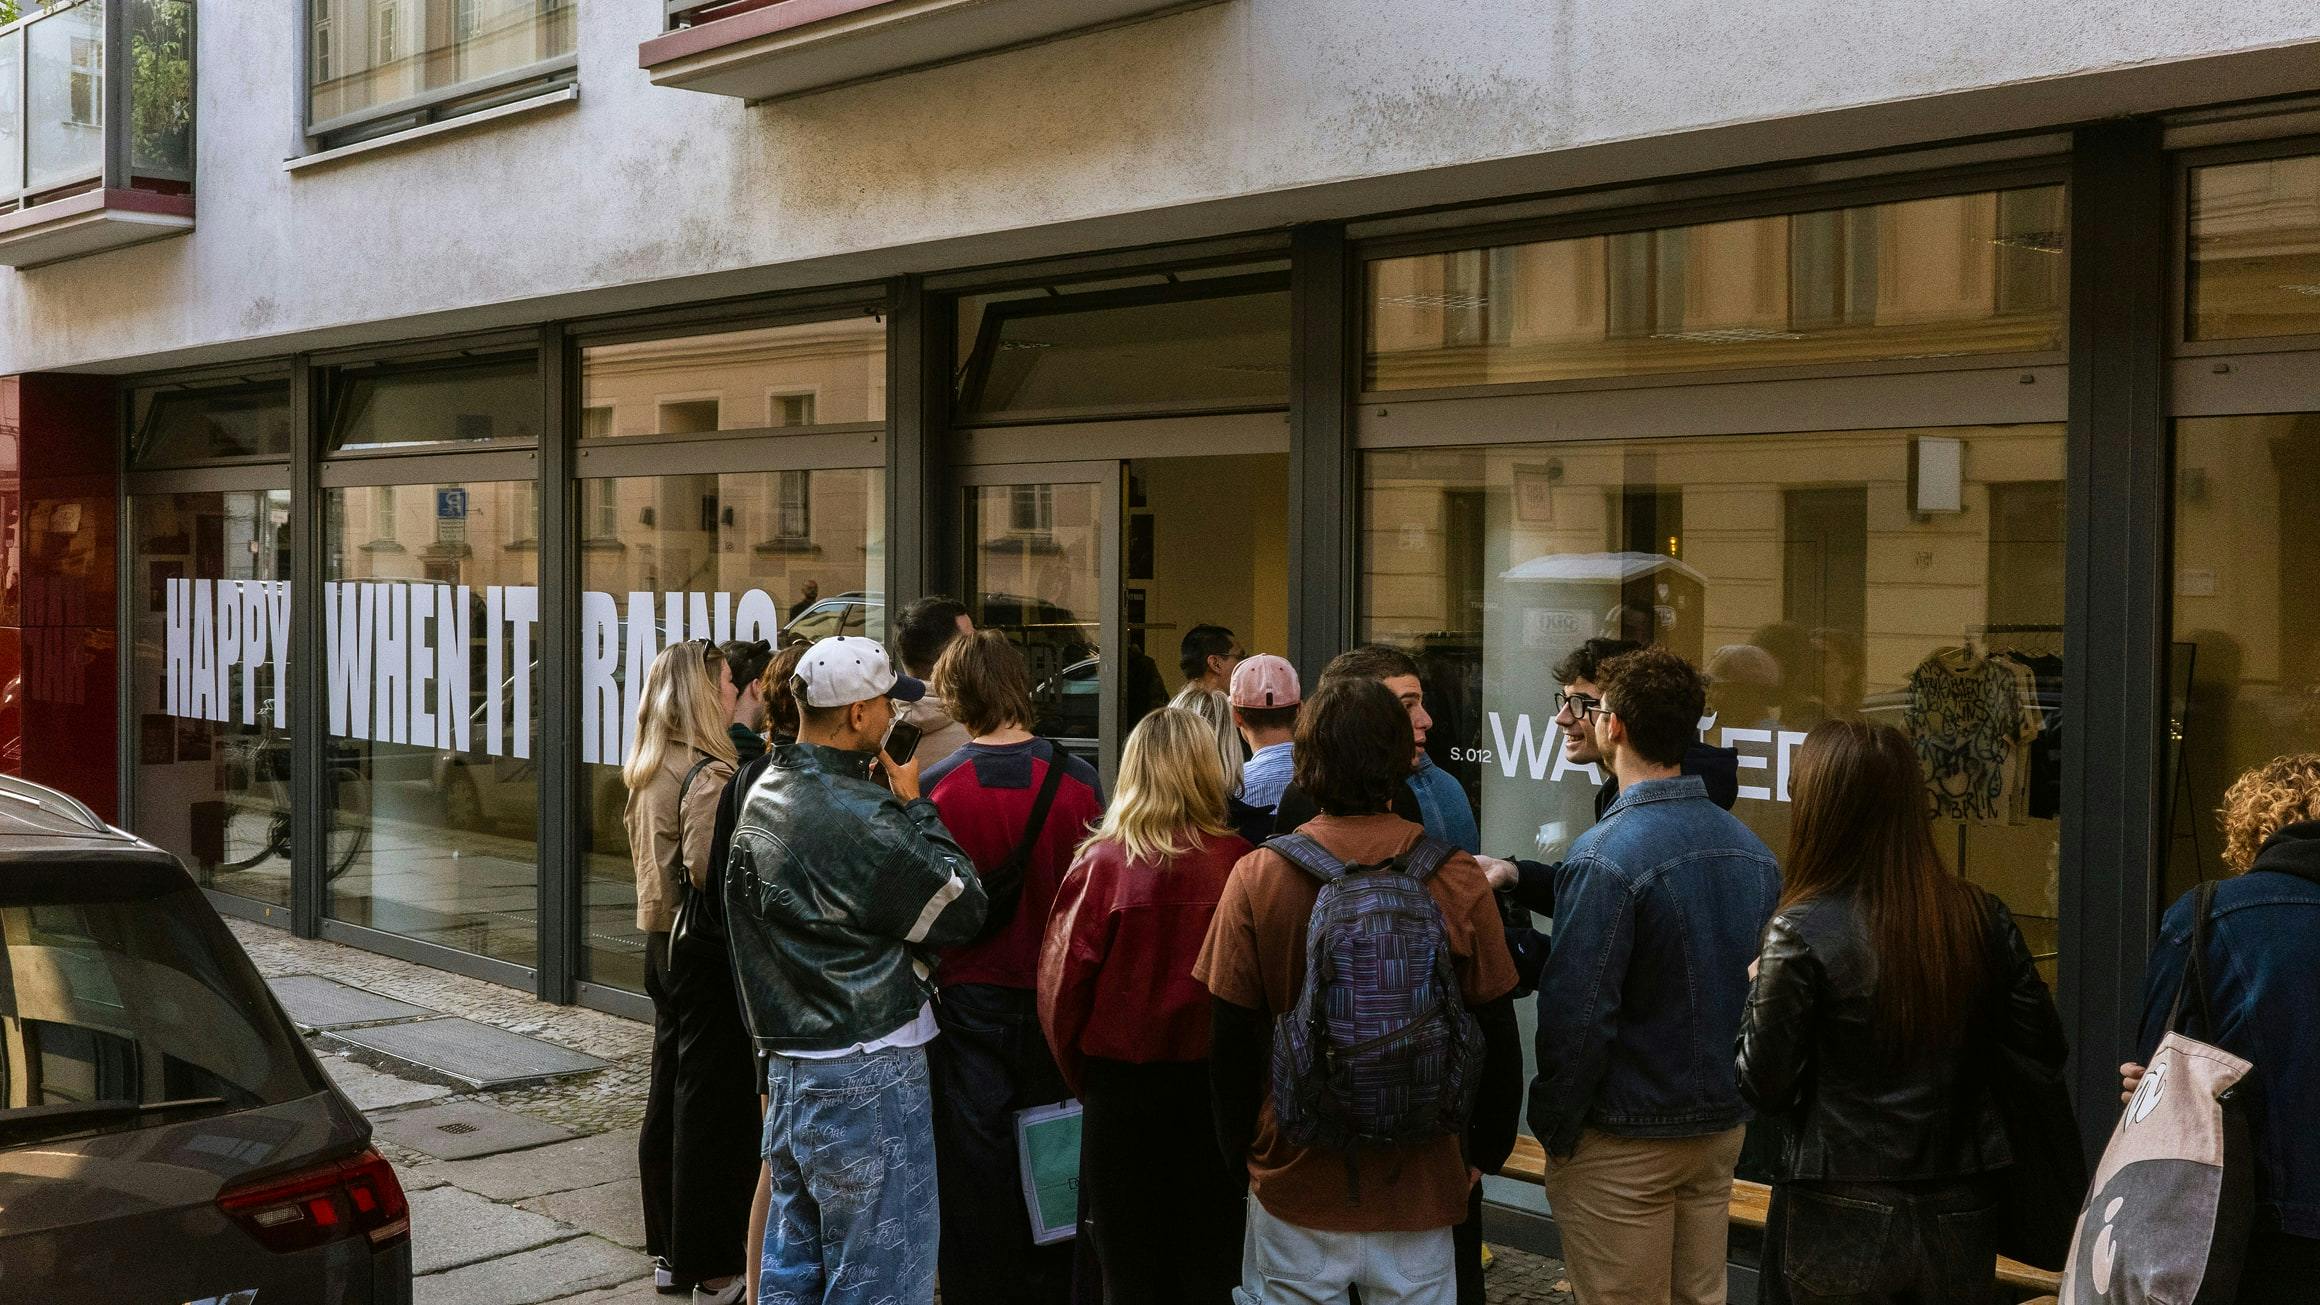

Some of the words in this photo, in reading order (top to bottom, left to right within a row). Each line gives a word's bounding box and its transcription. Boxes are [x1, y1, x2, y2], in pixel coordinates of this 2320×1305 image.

[167, 578, 291, 728] HAPPY
[325, 582, 470, 752] WHEN
[487, 586, 539, 759] IT
[1488, 711, 1808, 802] WAE
